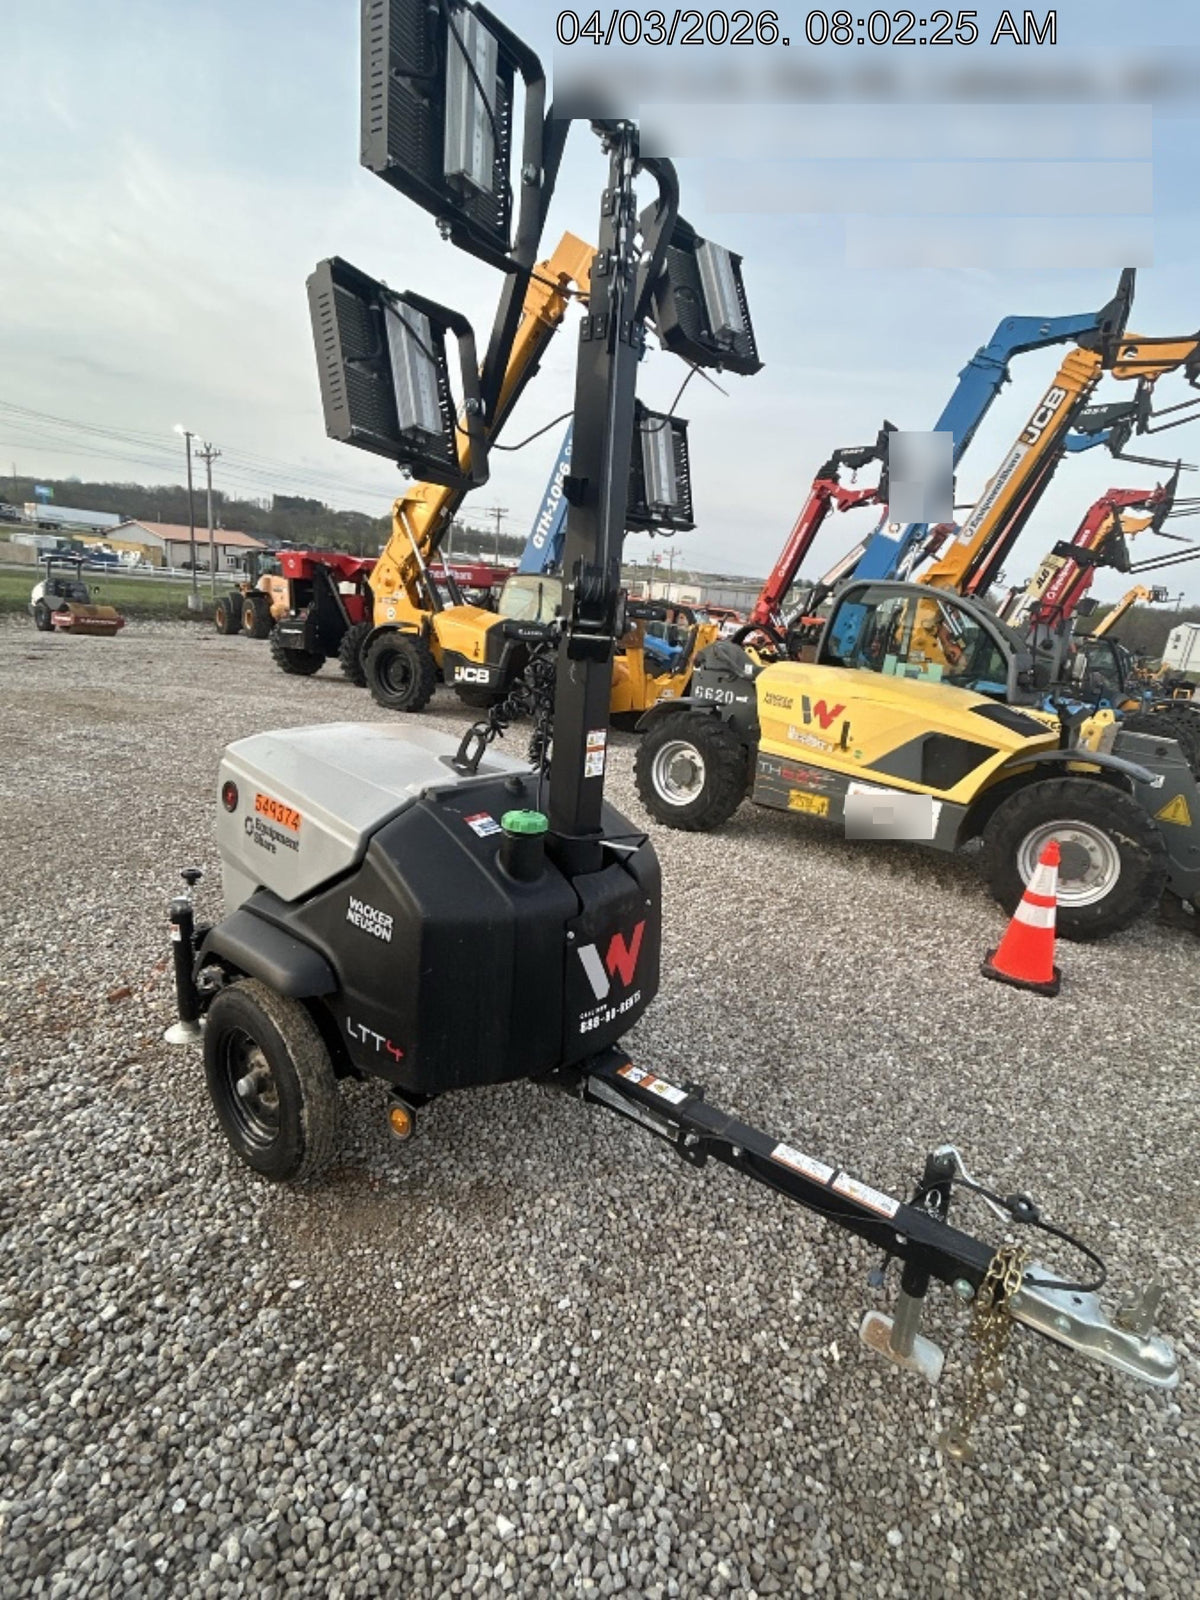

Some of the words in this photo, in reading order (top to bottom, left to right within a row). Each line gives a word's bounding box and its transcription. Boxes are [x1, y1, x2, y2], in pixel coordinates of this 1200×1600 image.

[1020, 387, 1067, 445] JCB
[454, 666, 490, 684] JCB
[255, 793, 300, 831] 549374
[346, 907, 393, 943] NEUSON
[349, 895, 394, 929] WACKER
[346, 1015, 404, 1063] LTT4
